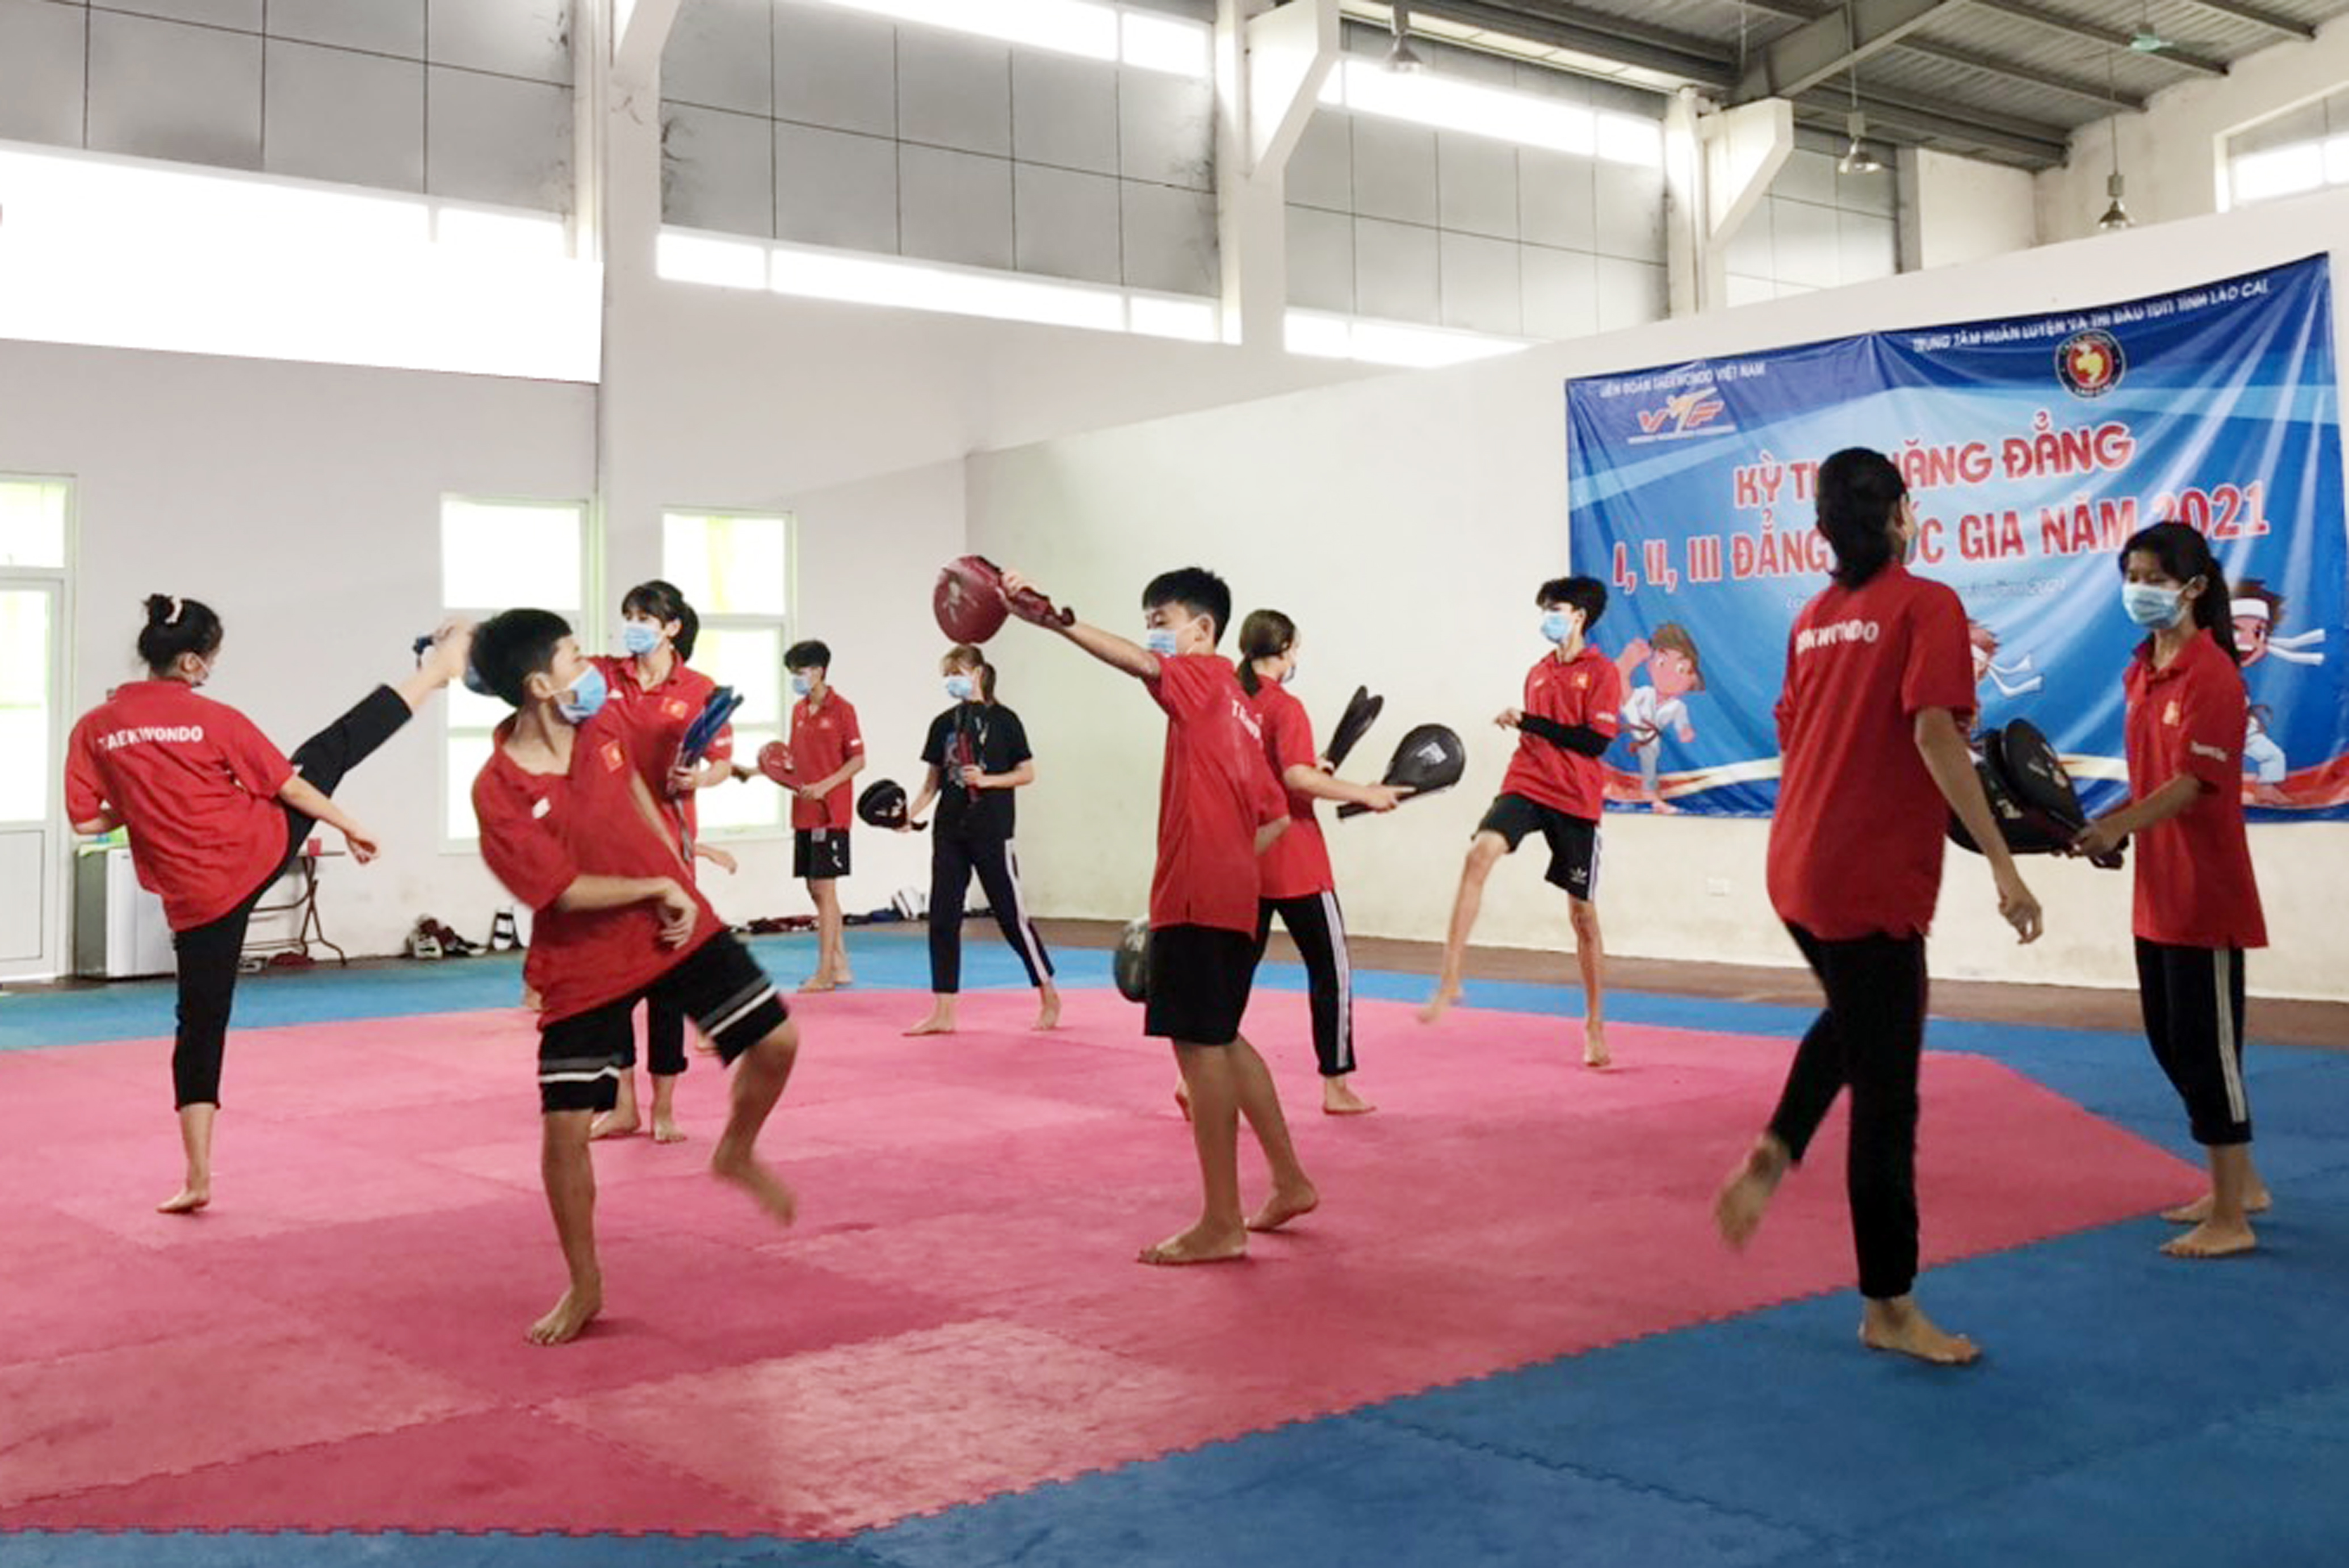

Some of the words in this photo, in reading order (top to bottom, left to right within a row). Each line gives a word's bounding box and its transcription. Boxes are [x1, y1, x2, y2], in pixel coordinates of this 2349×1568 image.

[2241, 278, 2269, 297] CAI
[1740, 362, 1765, 378] NAM
[1734, 450, 1784, 508] KỲ
[1893, 437, 1994, 489] ĂNG
[2001, 409, 2135, 479] ĐẲNG
[1688, 534, 1722, 582] III
[1731, 508, 1830, 579] ĐẲNG
[1958, 509, 2027, 563] GIA
[2041, 493, 2138, 557] NĂM
[2150, 480, 2270, 540] 2021
[98, 724, 204, 751] TAEKWONDO
